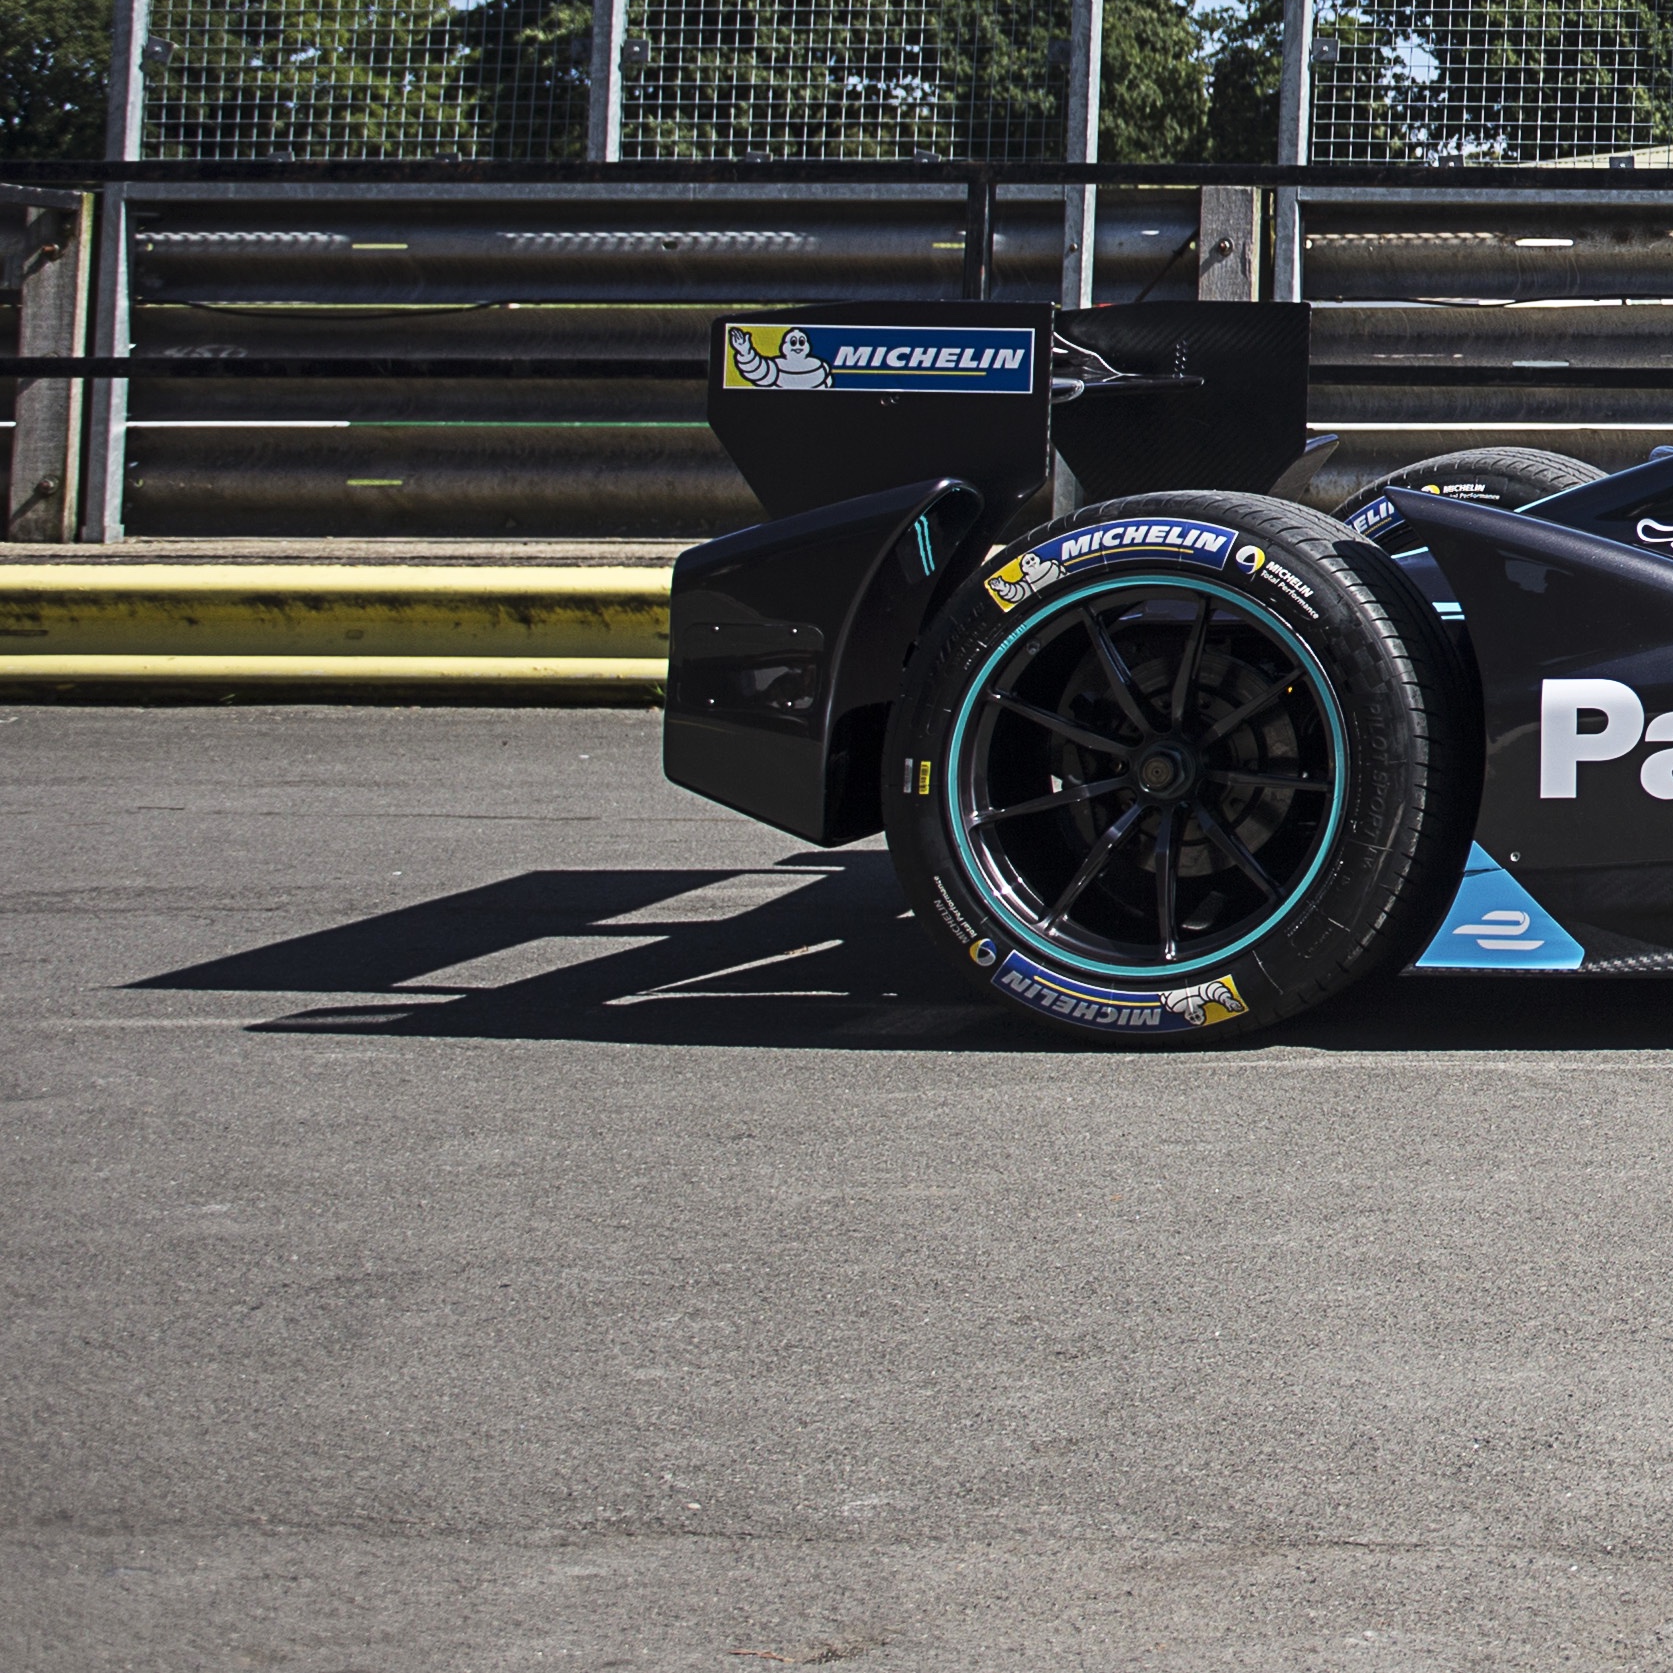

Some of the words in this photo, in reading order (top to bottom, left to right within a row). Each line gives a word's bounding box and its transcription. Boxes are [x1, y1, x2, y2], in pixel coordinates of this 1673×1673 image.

[833, 346, 1026, 369] MICHELIN
[1443, 483, 1486, 493] MICHELIN
[1061, 525, 1228, 561] MICHELIN
[1260, 569, 1281, 585] Total
[1277, 581, 1320, 620] Performance
[1265, 561, 1314, 598] MICHELIN
[933, 875, 965, 923] Performance
[933, 899, 970, 945] MICHELIN
[1001, 969, 1163, 1027] MICHELIN
